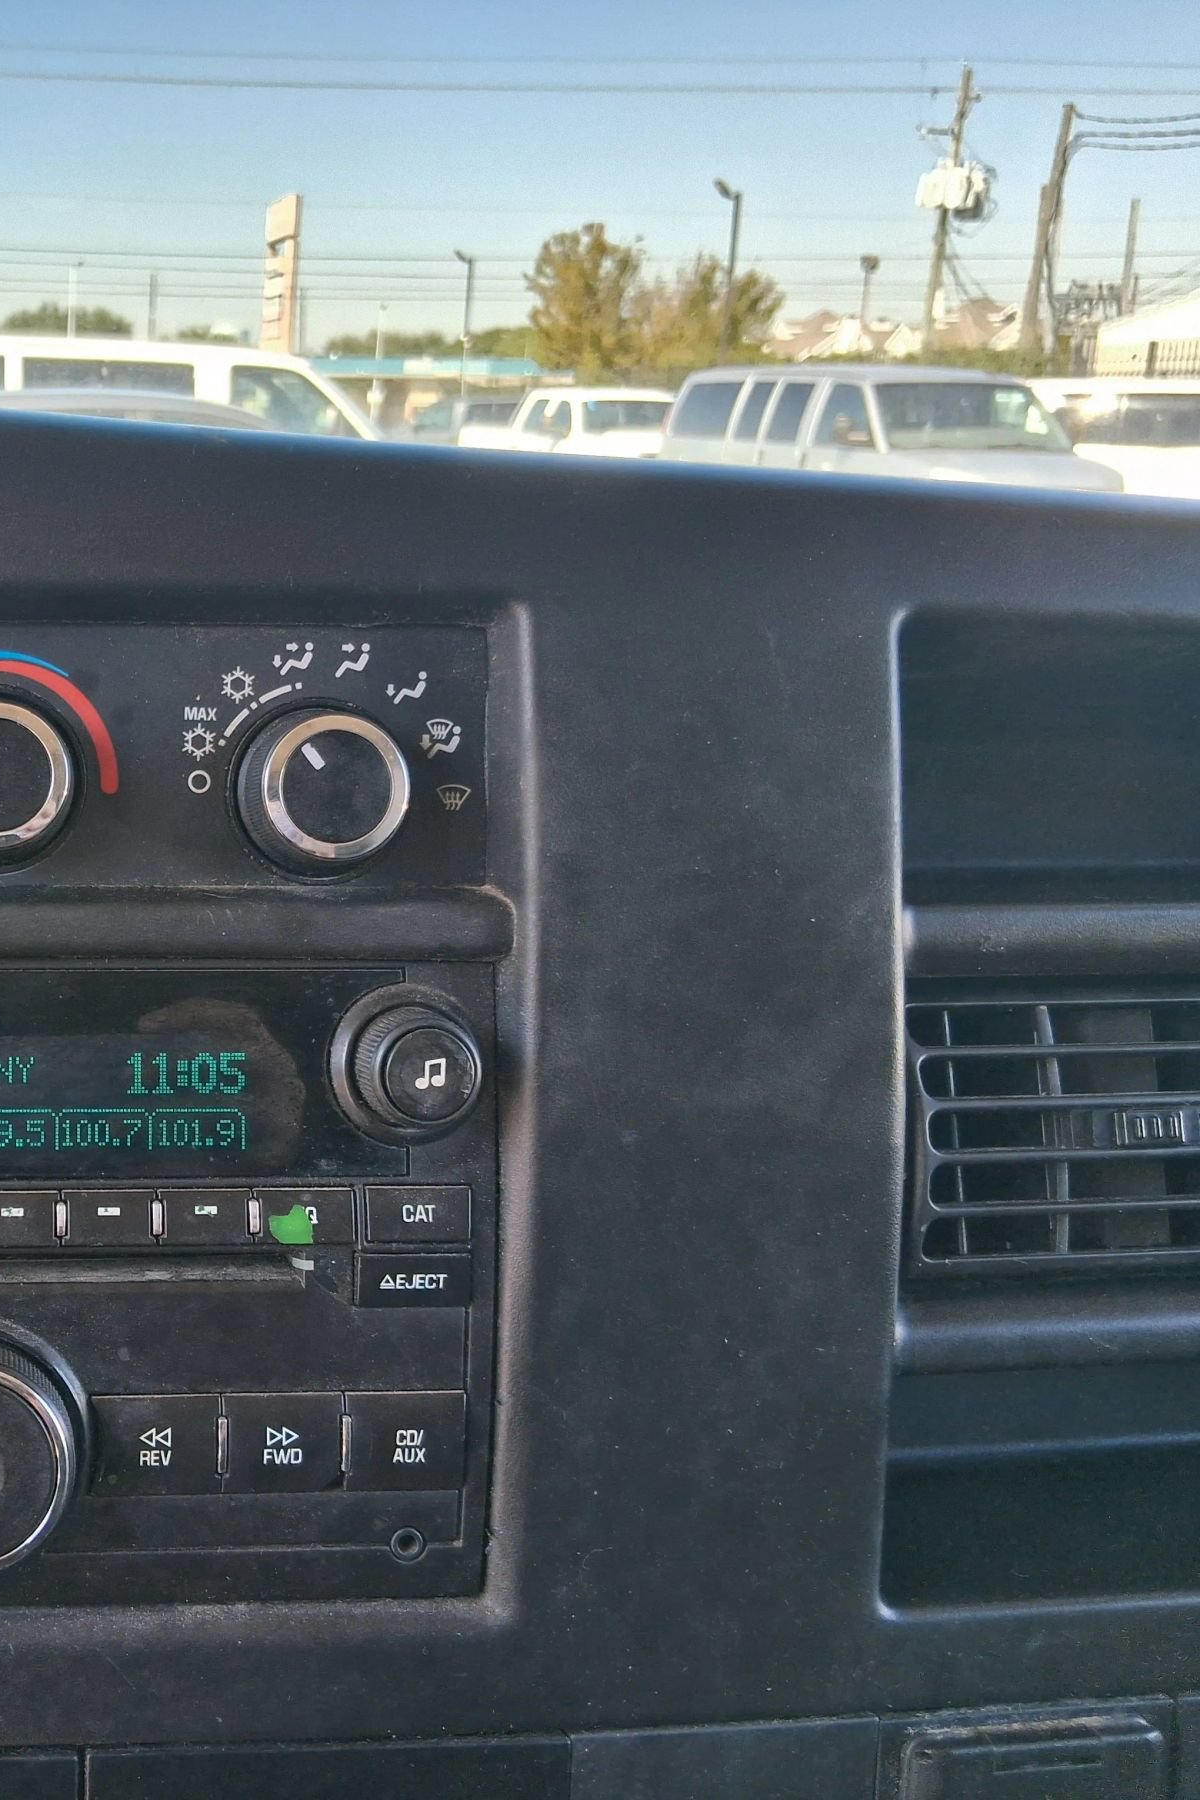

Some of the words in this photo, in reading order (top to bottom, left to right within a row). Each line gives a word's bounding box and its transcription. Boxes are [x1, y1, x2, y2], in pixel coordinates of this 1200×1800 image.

[183, 706, 217, 721] MAX
[127, 1052, 246, 1094] 11:05
[62, 1119, 142, 1146] 100.7
[159, 1119, 235, 1146] 101.9
[402, 1205, 436, 1223] CAT
[395, 1273, 448, 1290] EJECT
[395, 1429, 424, 1446] CD/
[139, 1451, 172, 1467] REV
[263, 1448, 303, 1465] FWD
[392, 1447, 426, 1464] AUX
